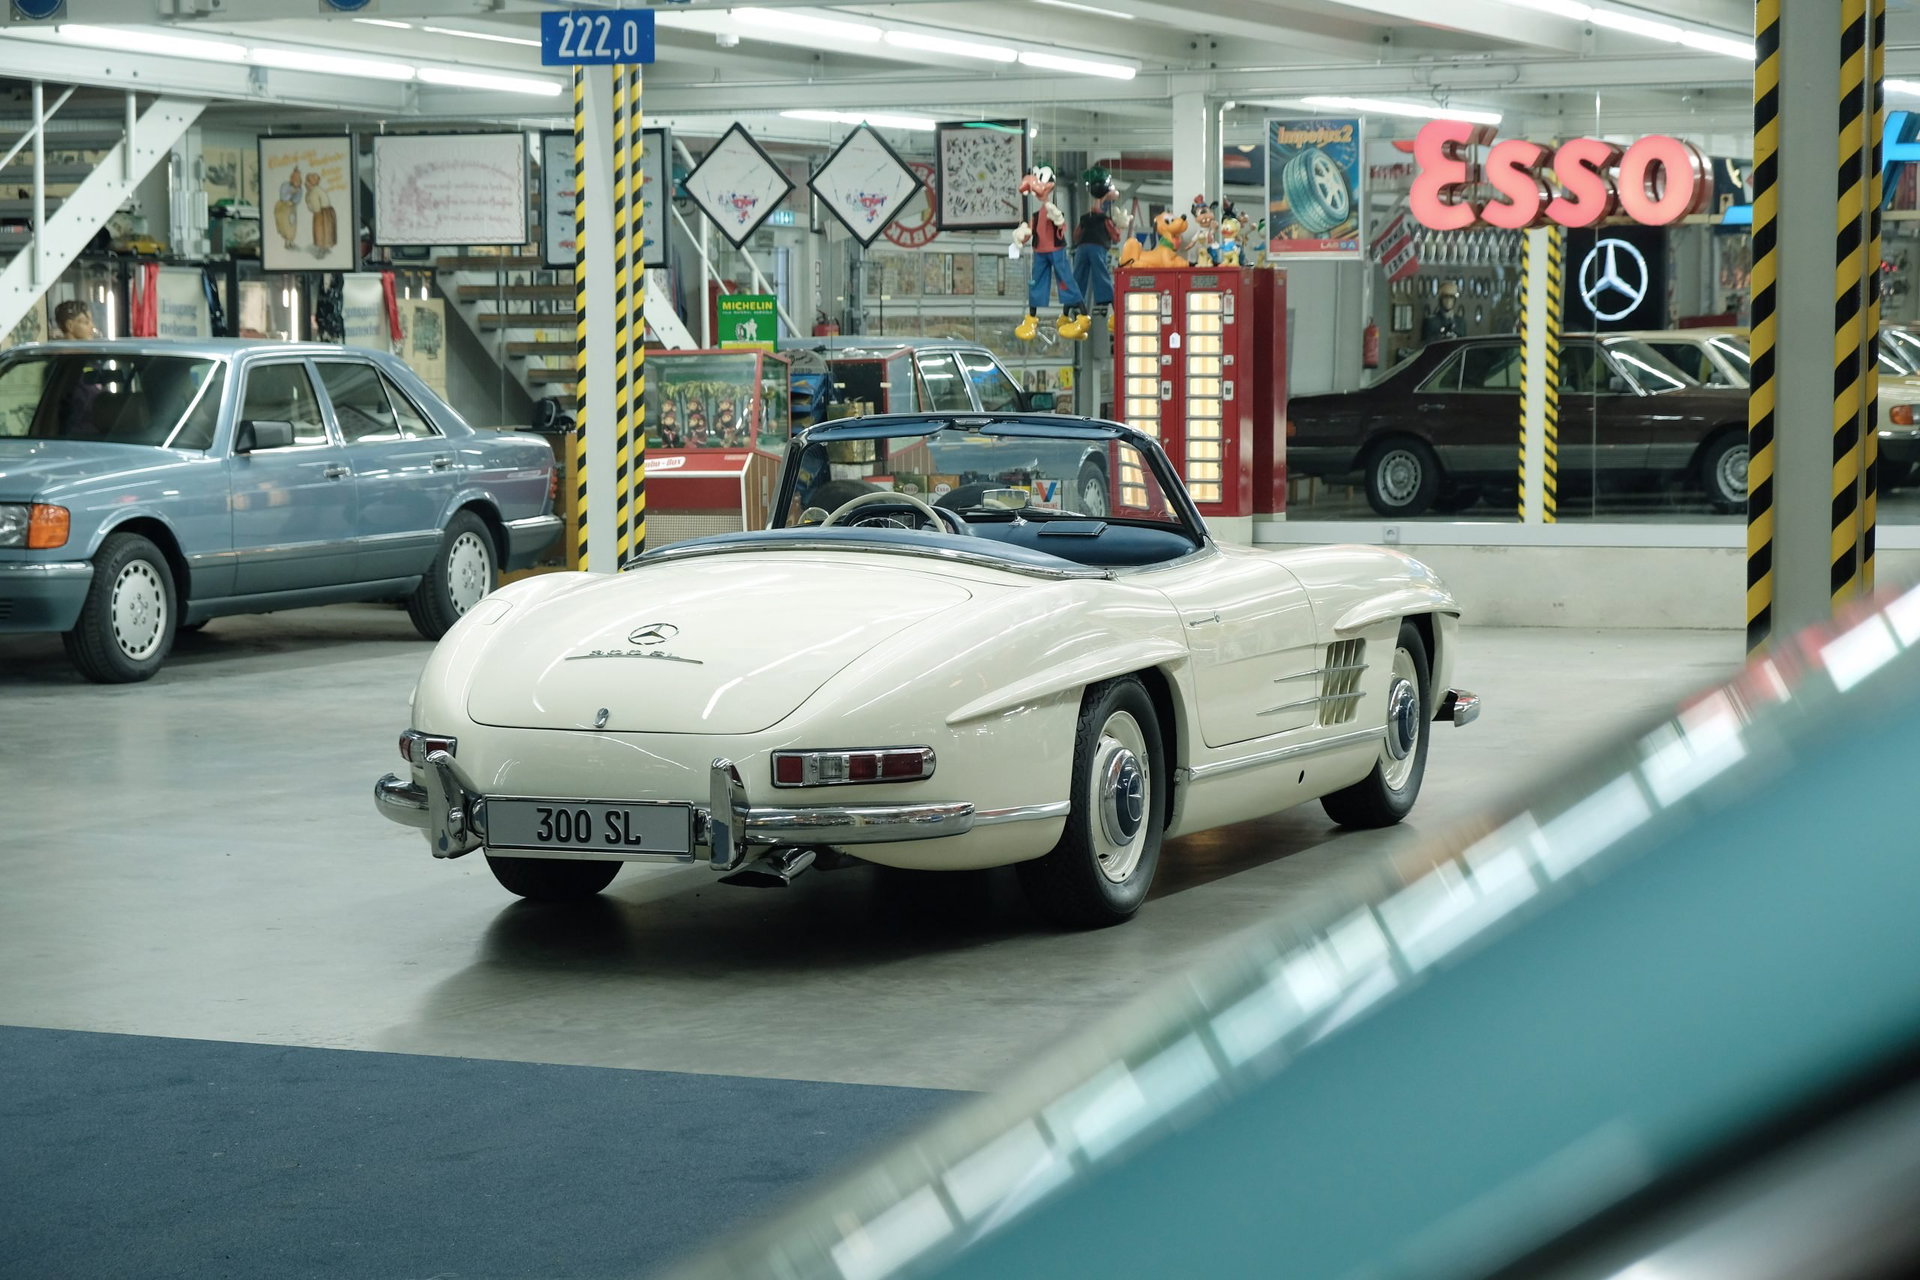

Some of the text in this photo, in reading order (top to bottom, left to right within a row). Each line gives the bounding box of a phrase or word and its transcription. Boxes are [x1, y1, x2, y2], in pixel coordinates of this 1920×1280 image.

[558, 15, 638, 61] 222,0
[722, 301, 773, 310] MICHELIN
[934, 485, 949, 493] Esso
[536, 807, 642, 846] 300 SL
